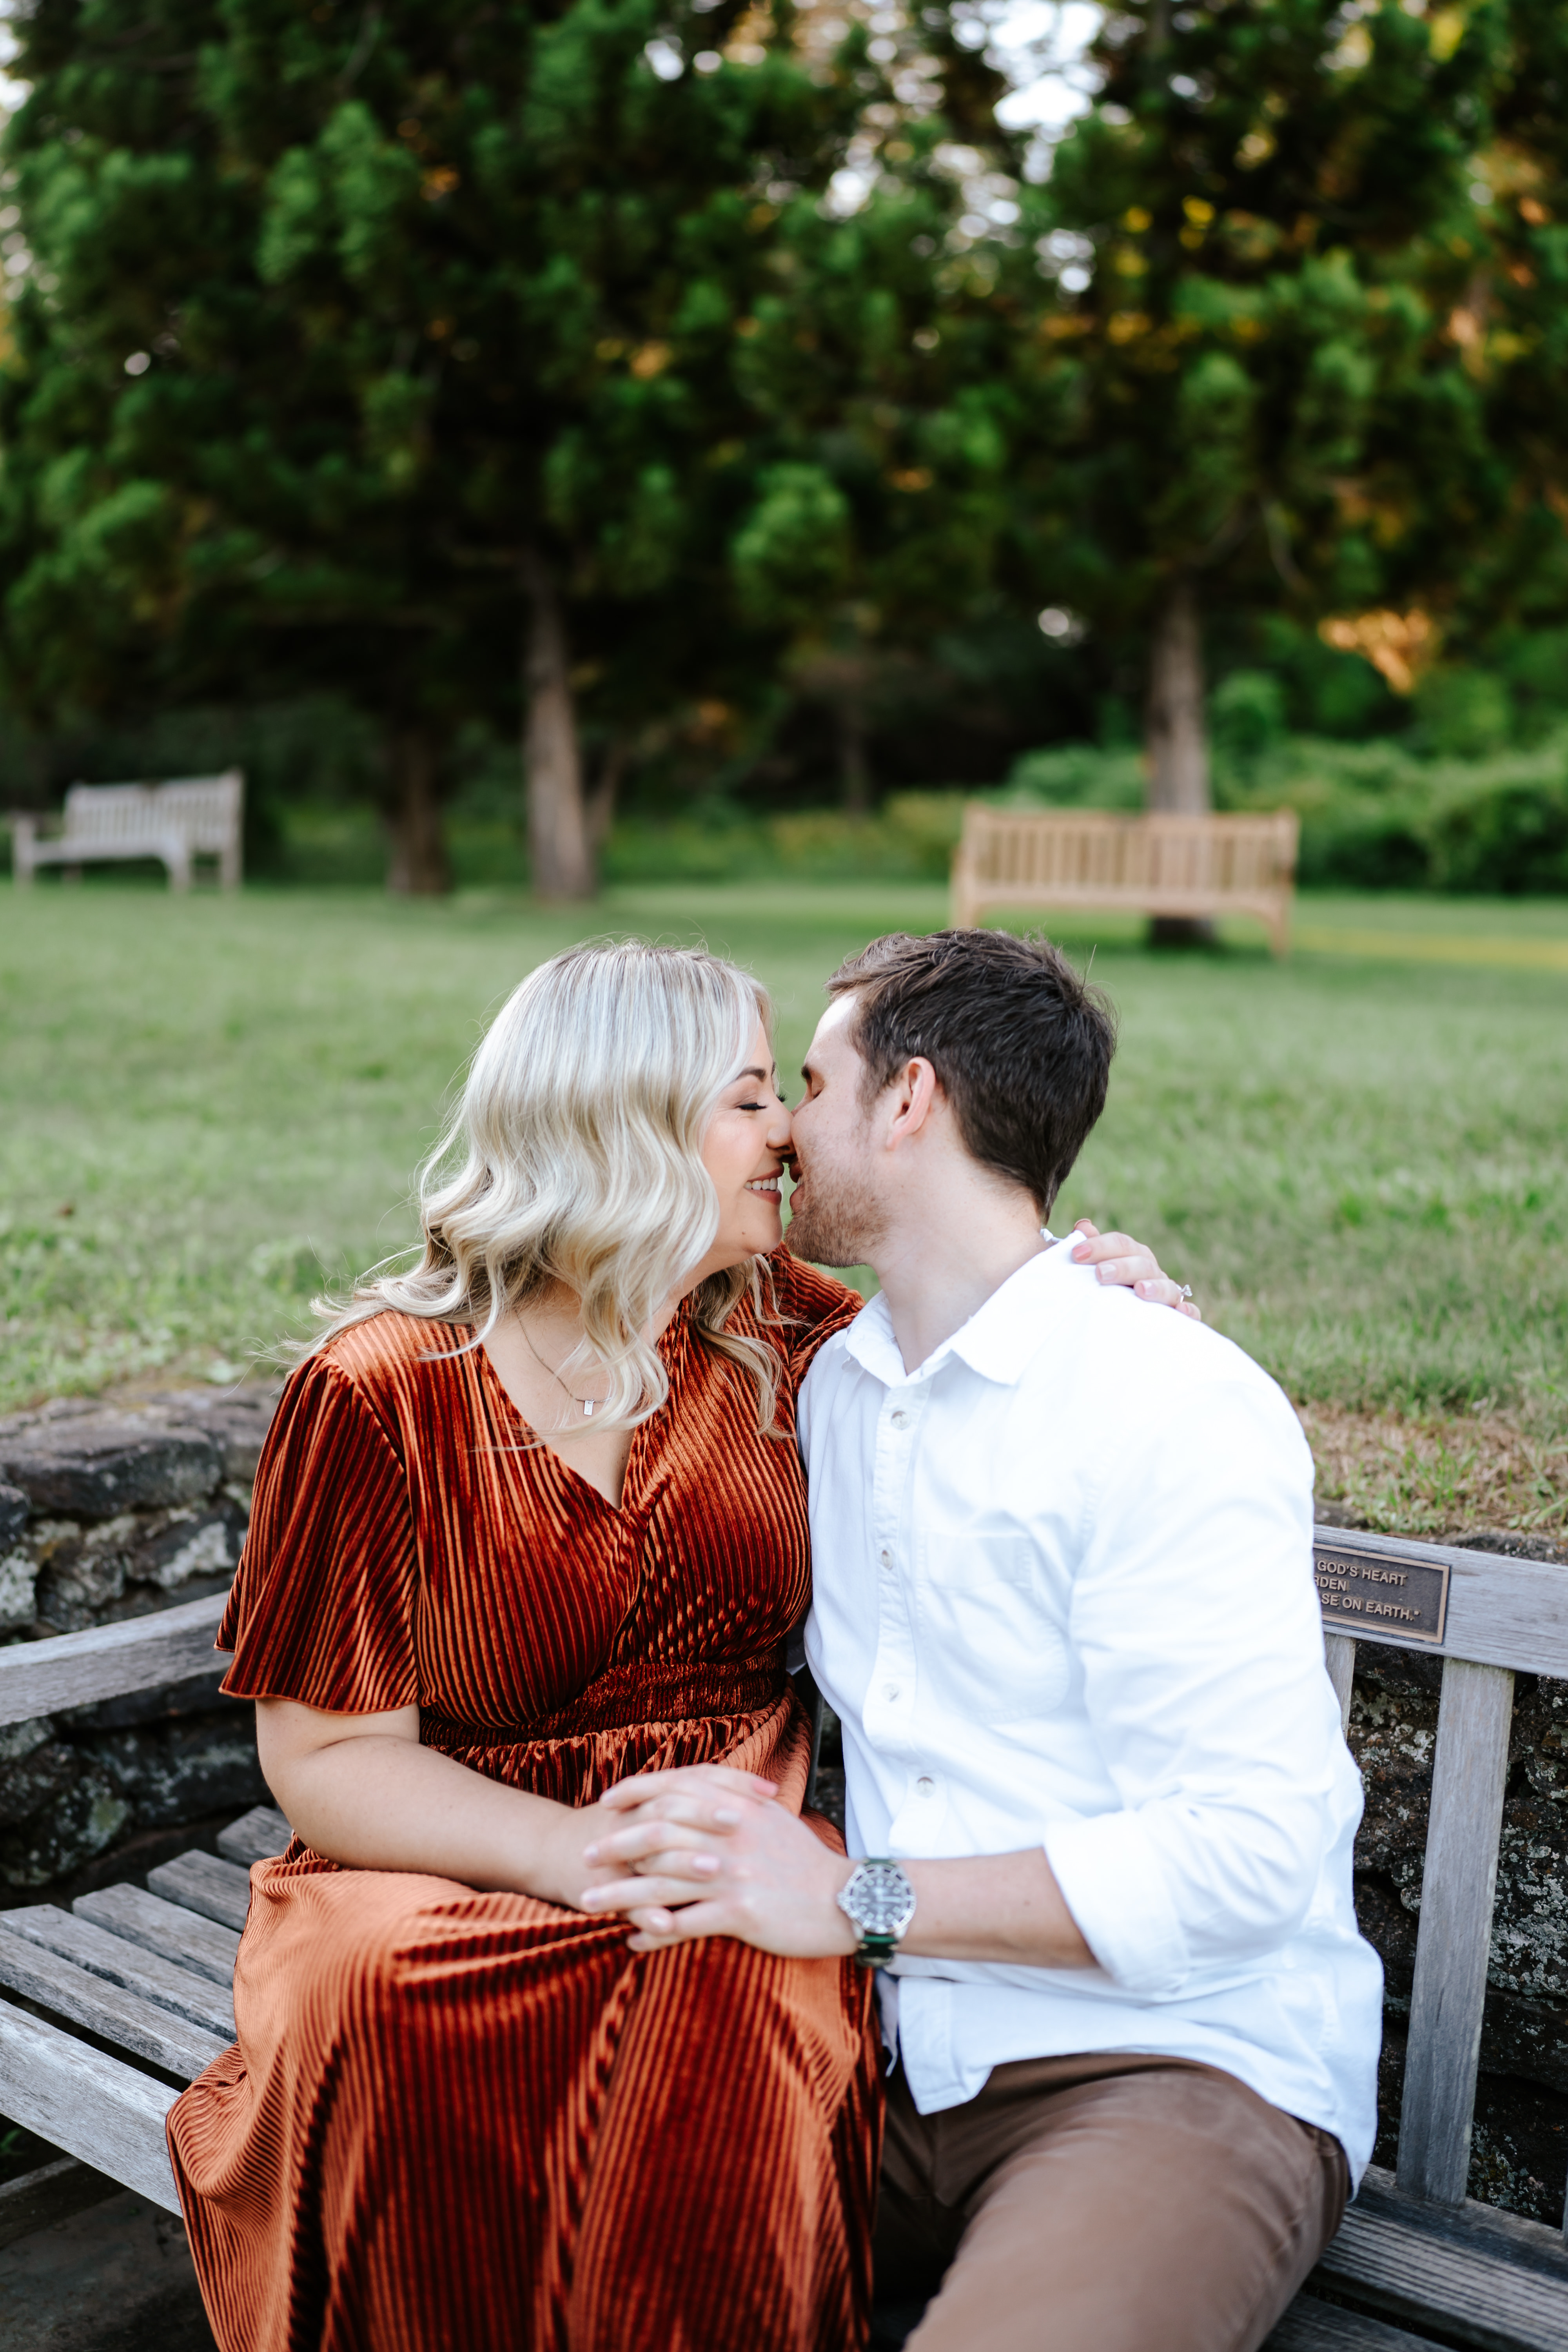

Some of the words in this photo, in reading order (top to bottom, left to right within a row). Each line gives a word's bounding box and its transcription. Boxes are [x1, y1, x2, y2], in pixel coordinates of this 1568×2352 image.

[1317, 1560, 1358, 1577] GOD'S
[1362, 1568, 1407, 1586] HEART
[1343, 1597, 1361, 1611] ON
